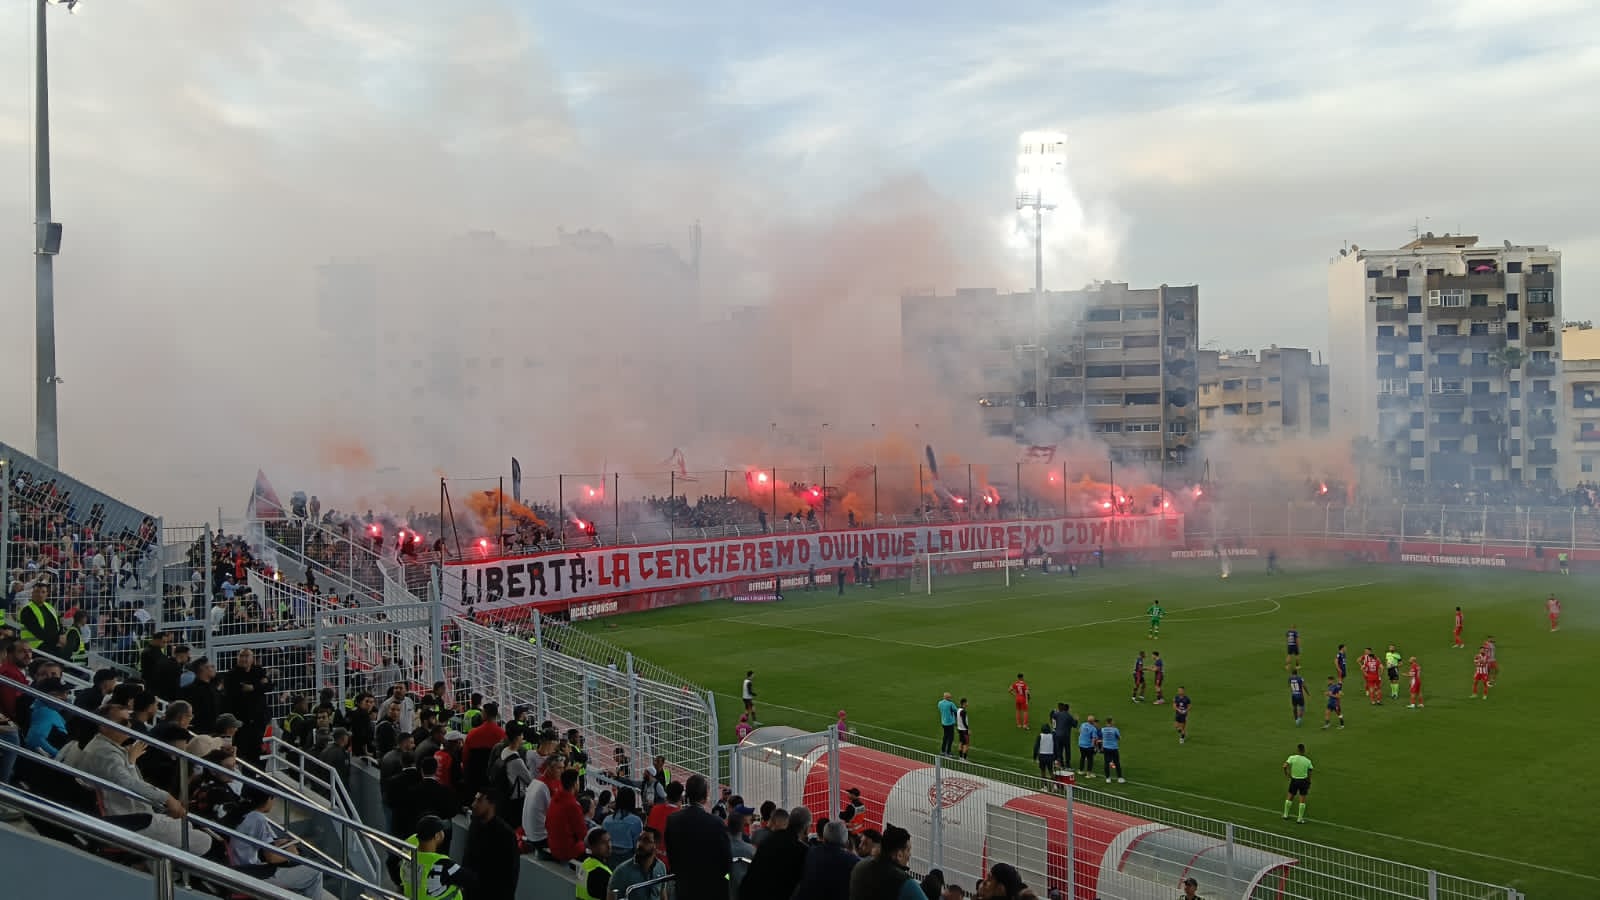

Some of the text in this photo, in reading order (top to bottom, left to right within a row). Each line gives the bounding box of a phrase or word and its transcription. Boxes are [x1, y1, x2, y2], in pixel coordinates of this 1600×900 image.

[459, 553, 593, 606] LIBERTÀ:
[597, 552, 632, 588] LA
[639, 538, 810, 580] CERCHEREMO
[927, 528, 955, 554] LA
[959, 524, 1055, 552] VIVREMO
[1061, 518, 1179, 546] COMUNUE
[1401, 553, 1431, 563] OFFICIAL
[1472, 556, 1506, 567] SPONSOR
[588, 601, 618, 615] SPONSOR
